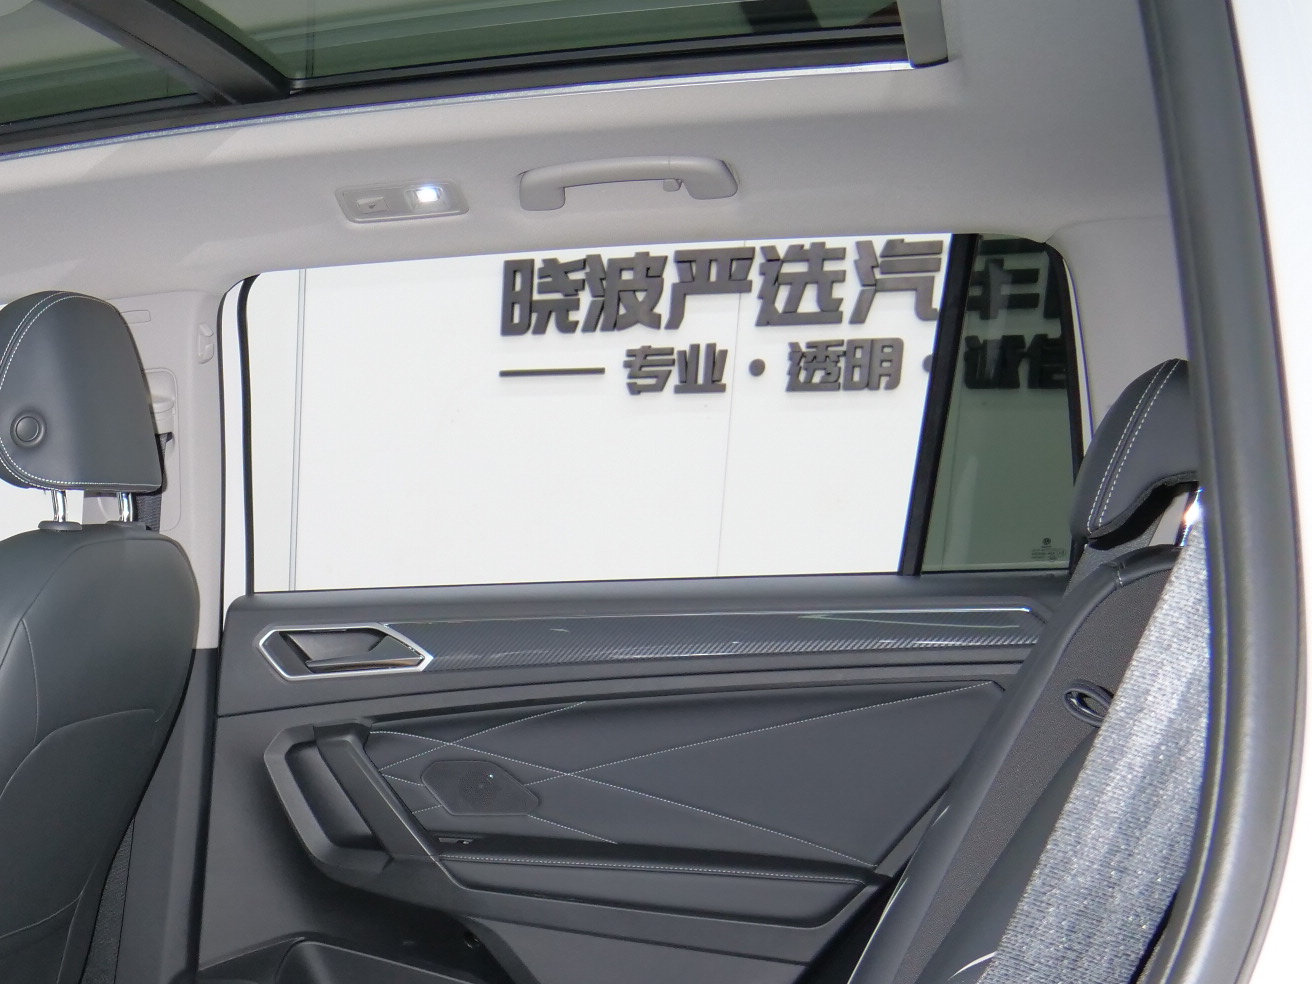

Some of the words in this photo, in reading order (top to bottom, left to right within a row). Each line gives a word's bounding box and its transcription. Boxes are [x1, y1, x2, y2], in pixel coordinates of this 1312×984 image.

[501, 237, 1058, 336] 晓波严选汽车
